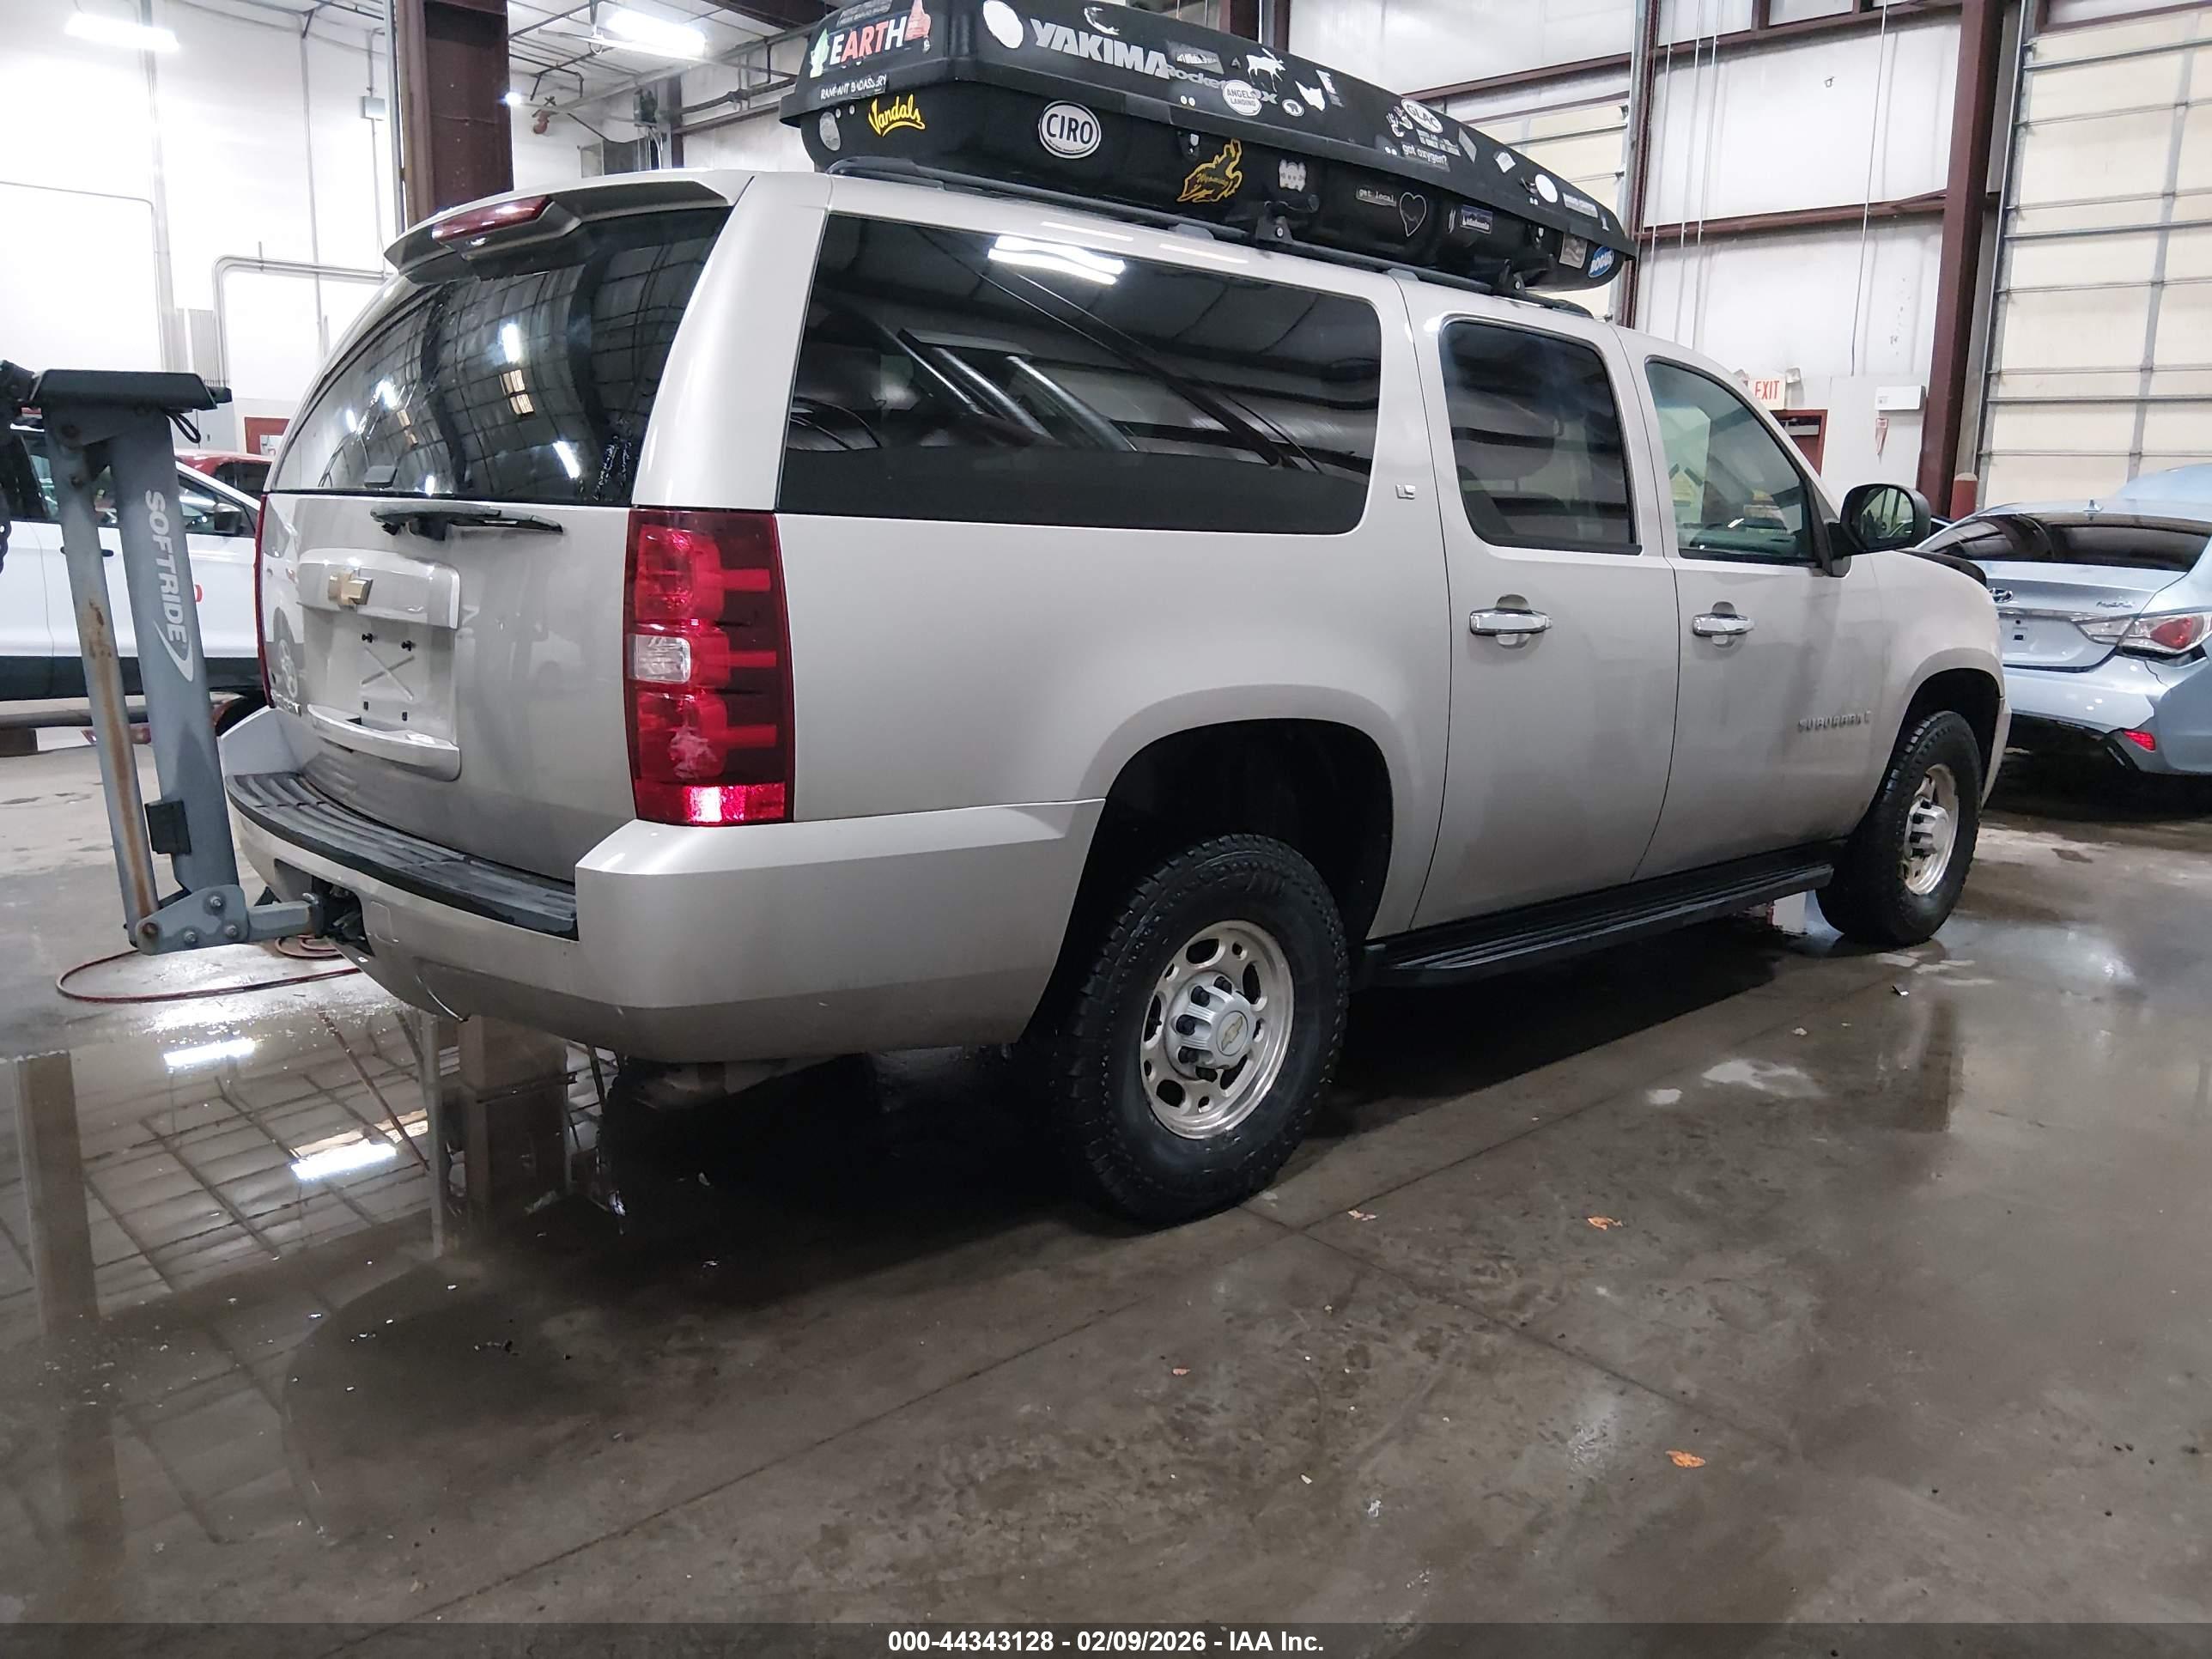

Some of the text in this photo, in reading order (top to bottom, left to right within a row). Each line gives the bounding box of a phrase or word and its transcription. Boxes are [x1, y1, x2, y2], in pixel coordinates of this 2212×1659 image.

[830, 16, 907, 65] EARTH
[1030, 18, 1170, 80] YAKIMA
[1226, 88, 1256, 99] ANGELS
[1230, 98, 1256, 107] LANDING
[868, 94, 925, 137] Vandals
[1407, 104, 1439, 126] GLAC
[1046, 113, 1093, 144] CIRO
[1402, 144, 1447, 165] got oxygen?
[1376, 191, 1394, 202] local
[1754, 380, 1779, 400] EXIT
[145, 489, 187, 643] SOFTRIDE
